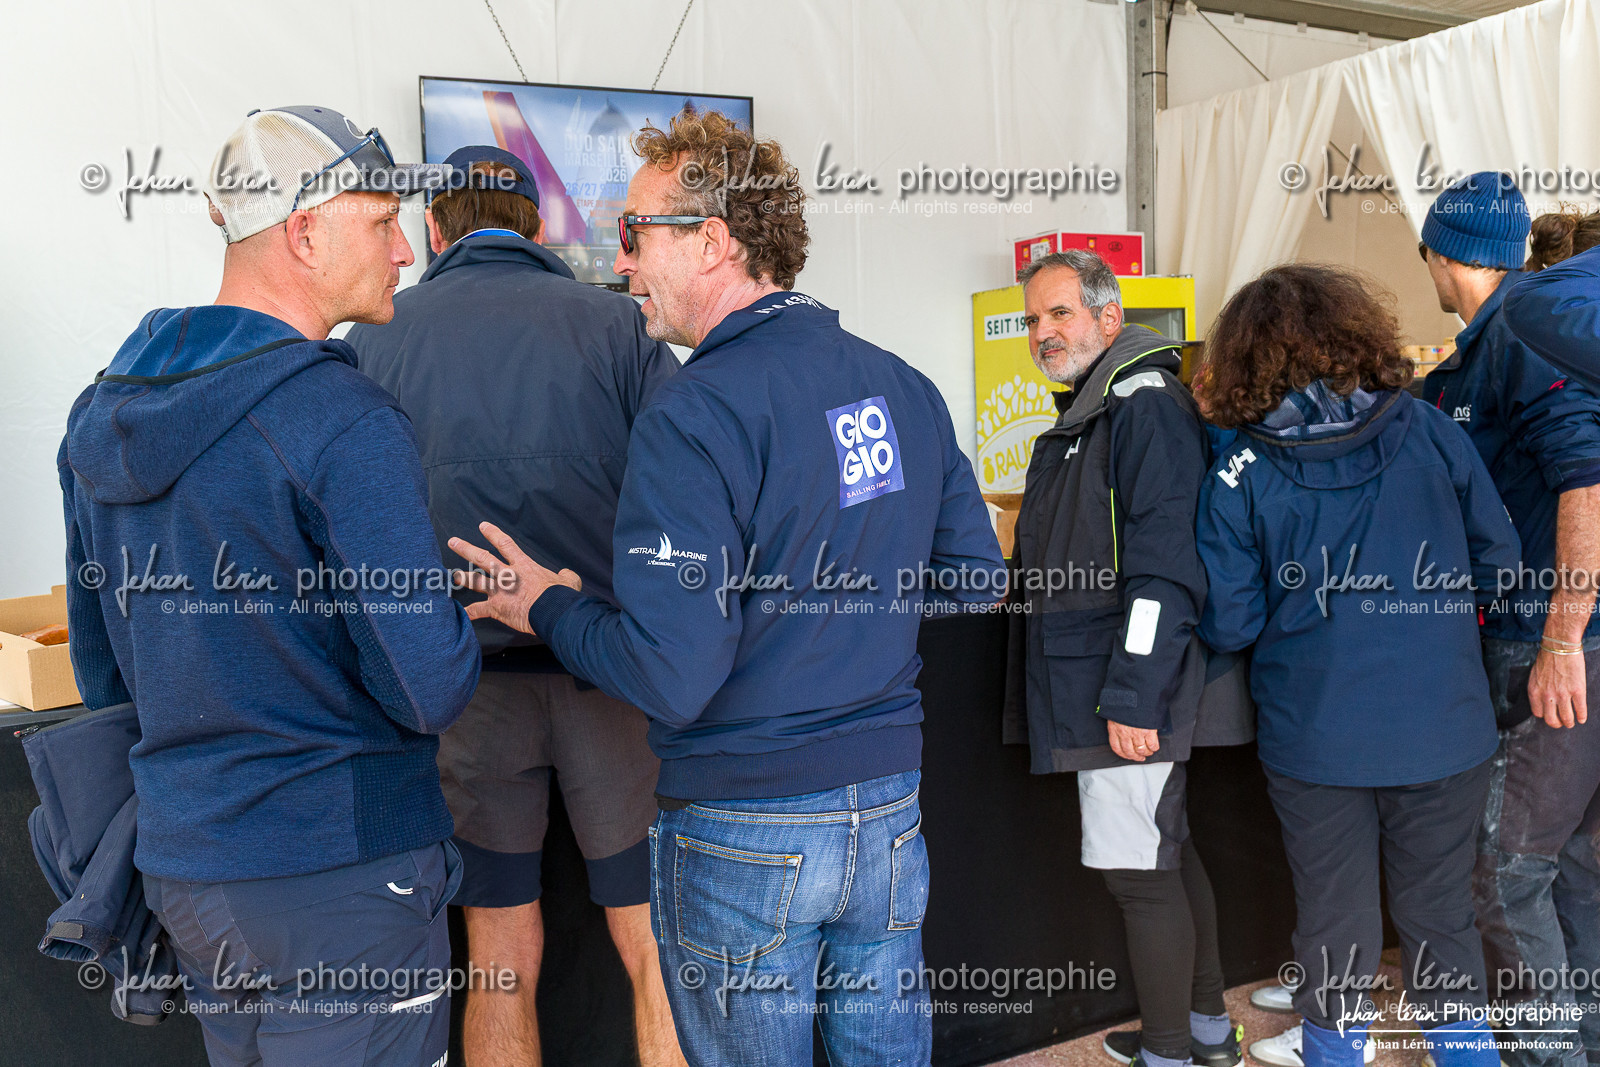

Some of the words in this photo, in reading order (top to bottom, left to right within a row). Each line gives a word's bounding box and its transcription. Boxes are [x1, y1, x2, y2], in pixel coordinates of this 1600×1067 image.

[987, 318, 1011, 335] SEIT
[1015, 316, 1026, 332] 19
[836, 405, 887, 449] GIO
[843, 440, 893, 485] GIO
[846, 484, 876, 499] SAILING
[672, 549, 707, 562] MARINE
